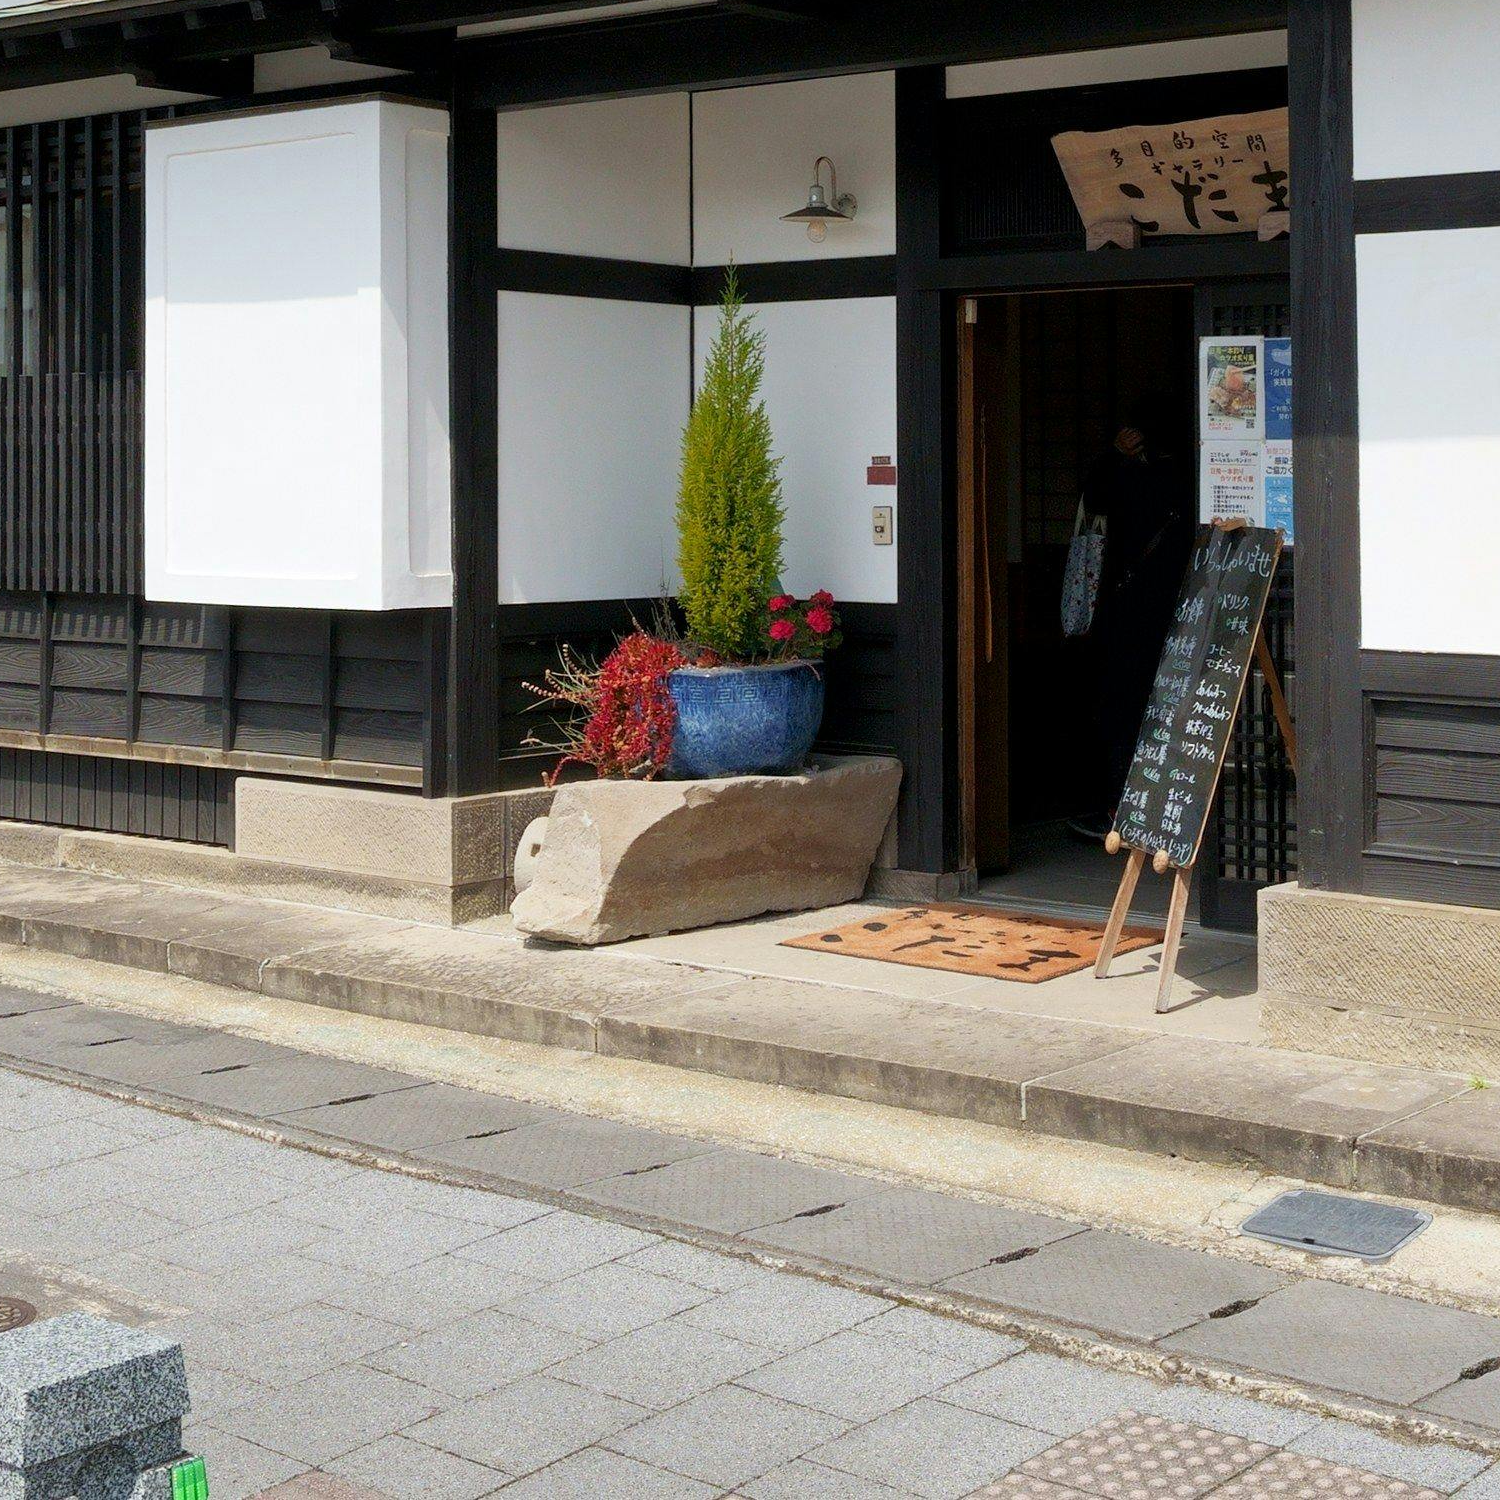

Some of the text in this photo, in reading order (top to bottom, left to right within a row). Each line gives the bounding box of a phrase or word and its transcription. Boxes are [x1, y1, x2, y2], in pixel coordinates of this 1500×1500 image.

[1109, 130, 1267, 169] 多目的空間
[1151, 156, 1244, 176] ギャラリー
[1194, 541, 1272, 578] いらっしゃいませ
[1209, 643, 1232, 657] コーヒー
[1195, 679, 1227, 699] あんみつ
